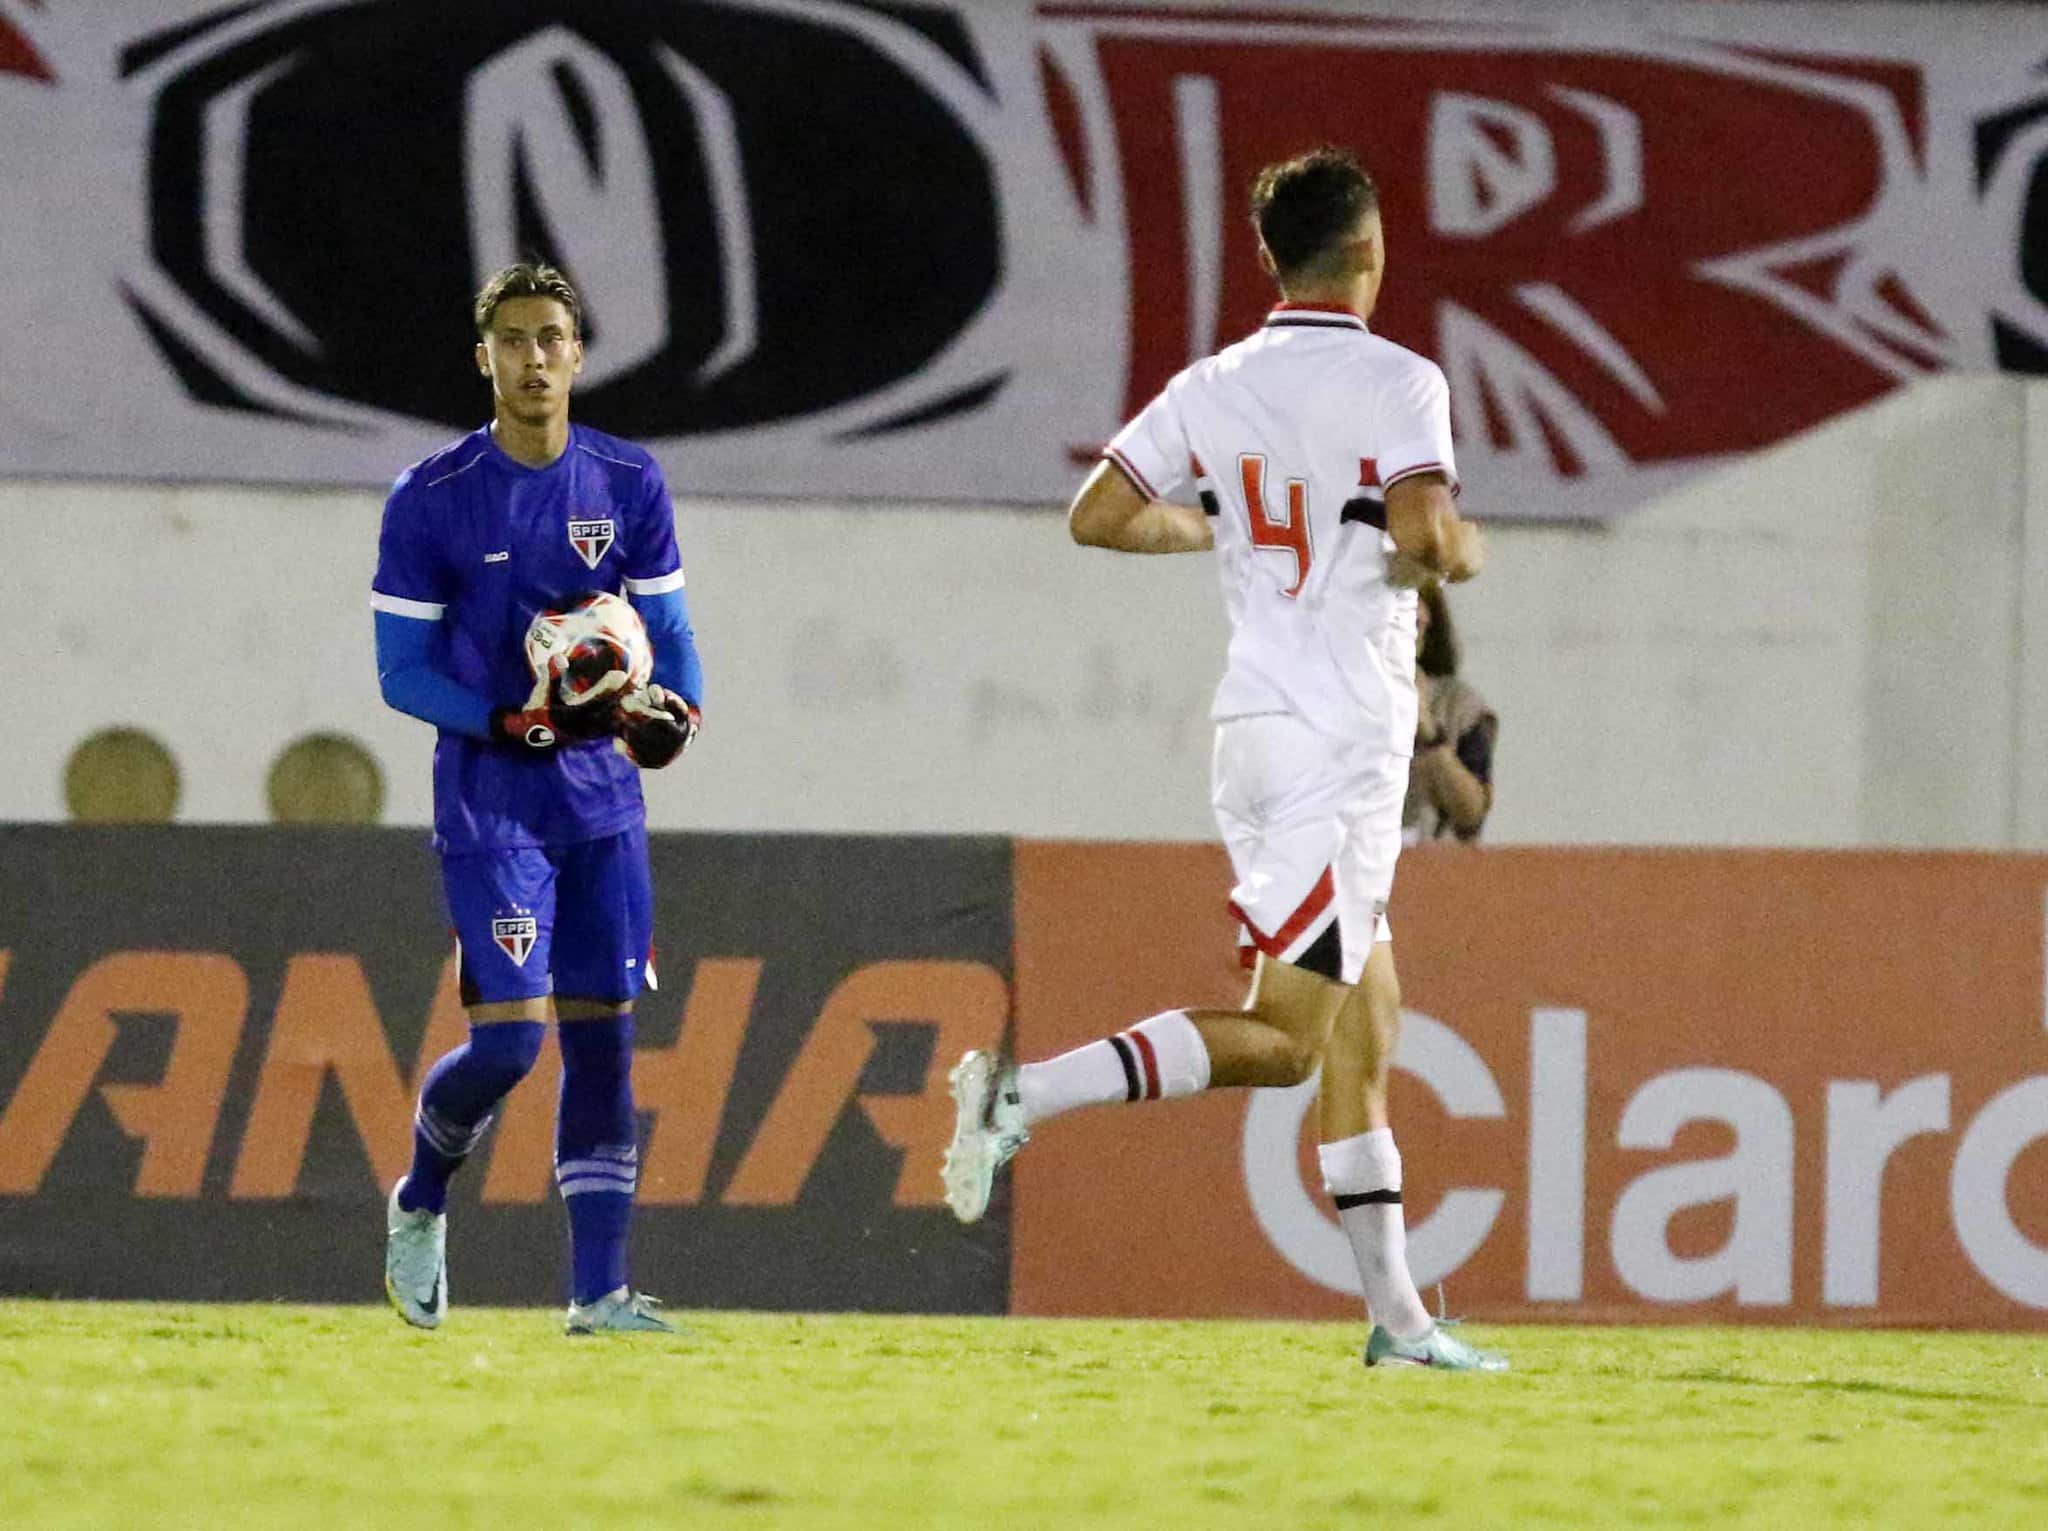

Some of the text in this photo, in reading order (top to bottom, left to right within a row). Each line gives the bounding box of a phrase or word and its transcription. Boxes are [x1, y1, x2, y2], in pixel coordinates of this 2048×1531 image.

[572, 525, 610, 536] SPFC
[1237, 452, 1315, 600] 4
[498, 923, 534, 934] SPFC
[0, 952, 1008, 1207] ANHA
